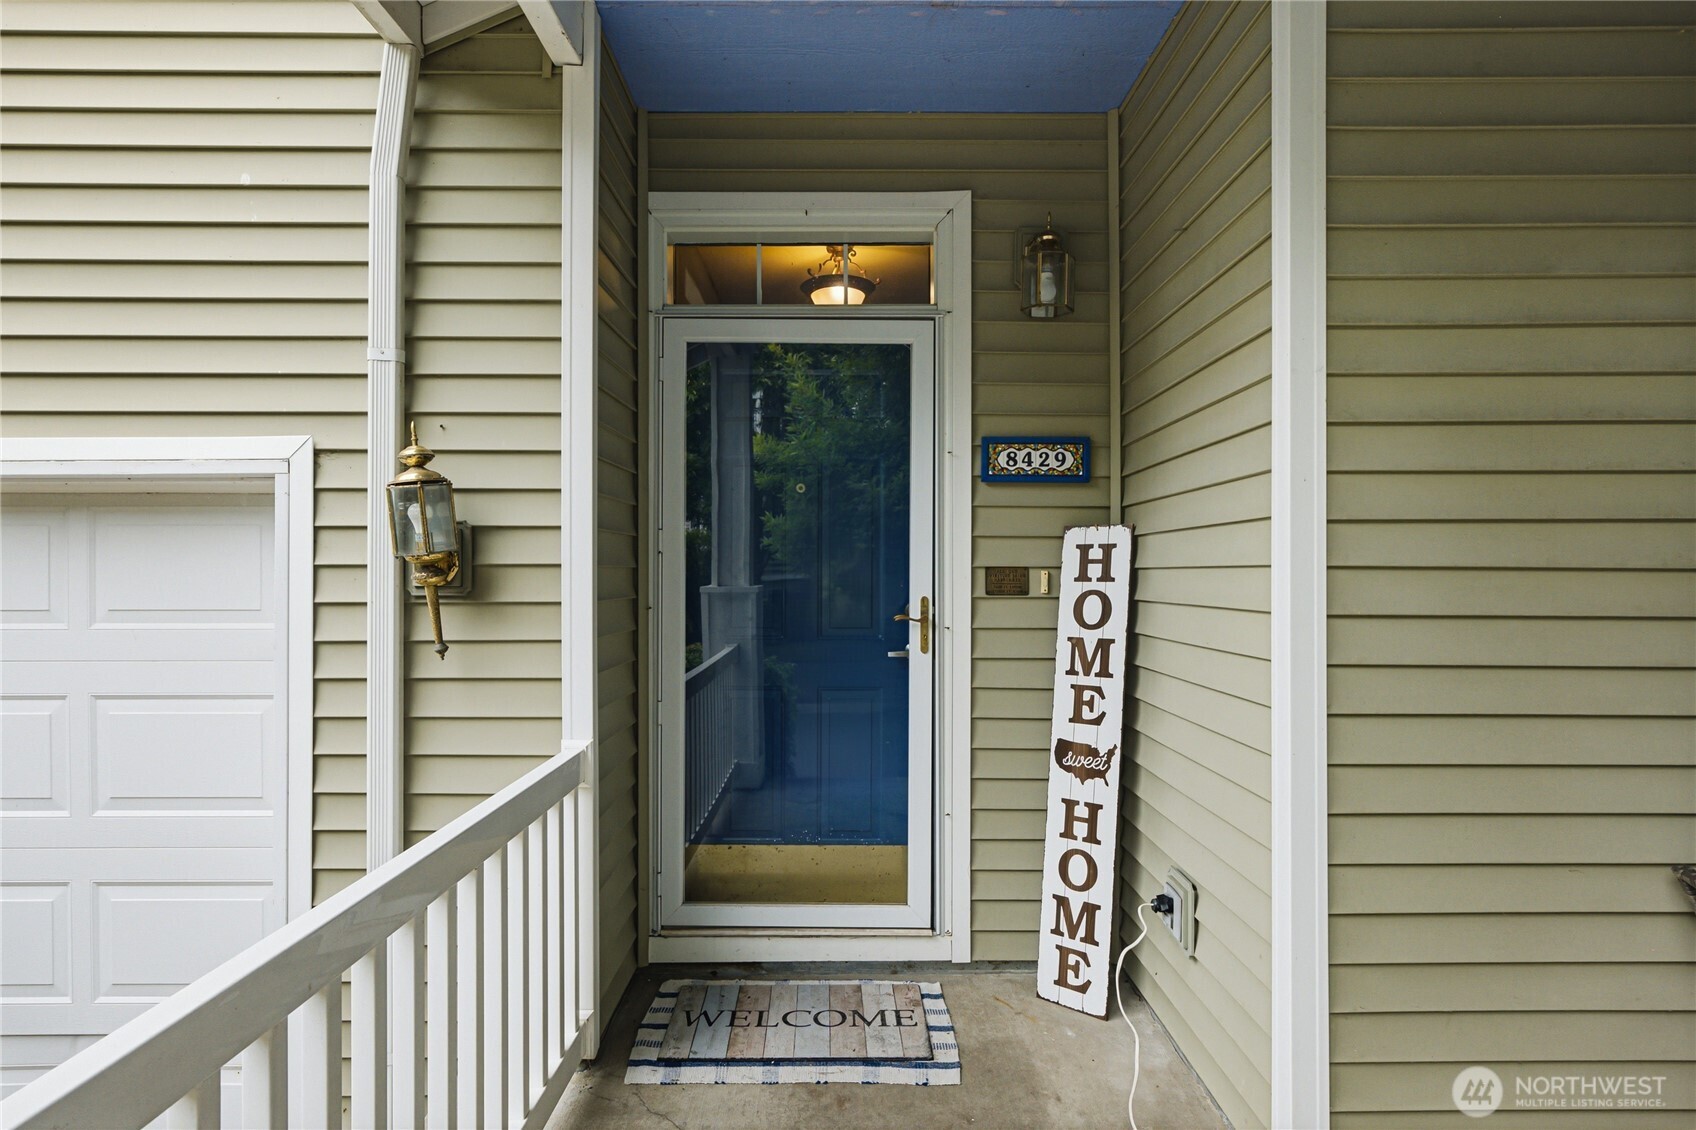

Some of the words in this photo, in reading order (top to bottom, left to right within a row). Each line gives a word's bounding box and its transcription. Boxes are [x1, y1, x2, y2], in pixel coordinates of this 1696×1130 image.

[1006, 451, 1067, 468] 8429
[1065, 543, 1117, 726] HOME
[1063, 751, 1108, 770] sweet
[1050, 798, 1103, 994] HOME
[683, 1009, 918, 1028] WELCOME
